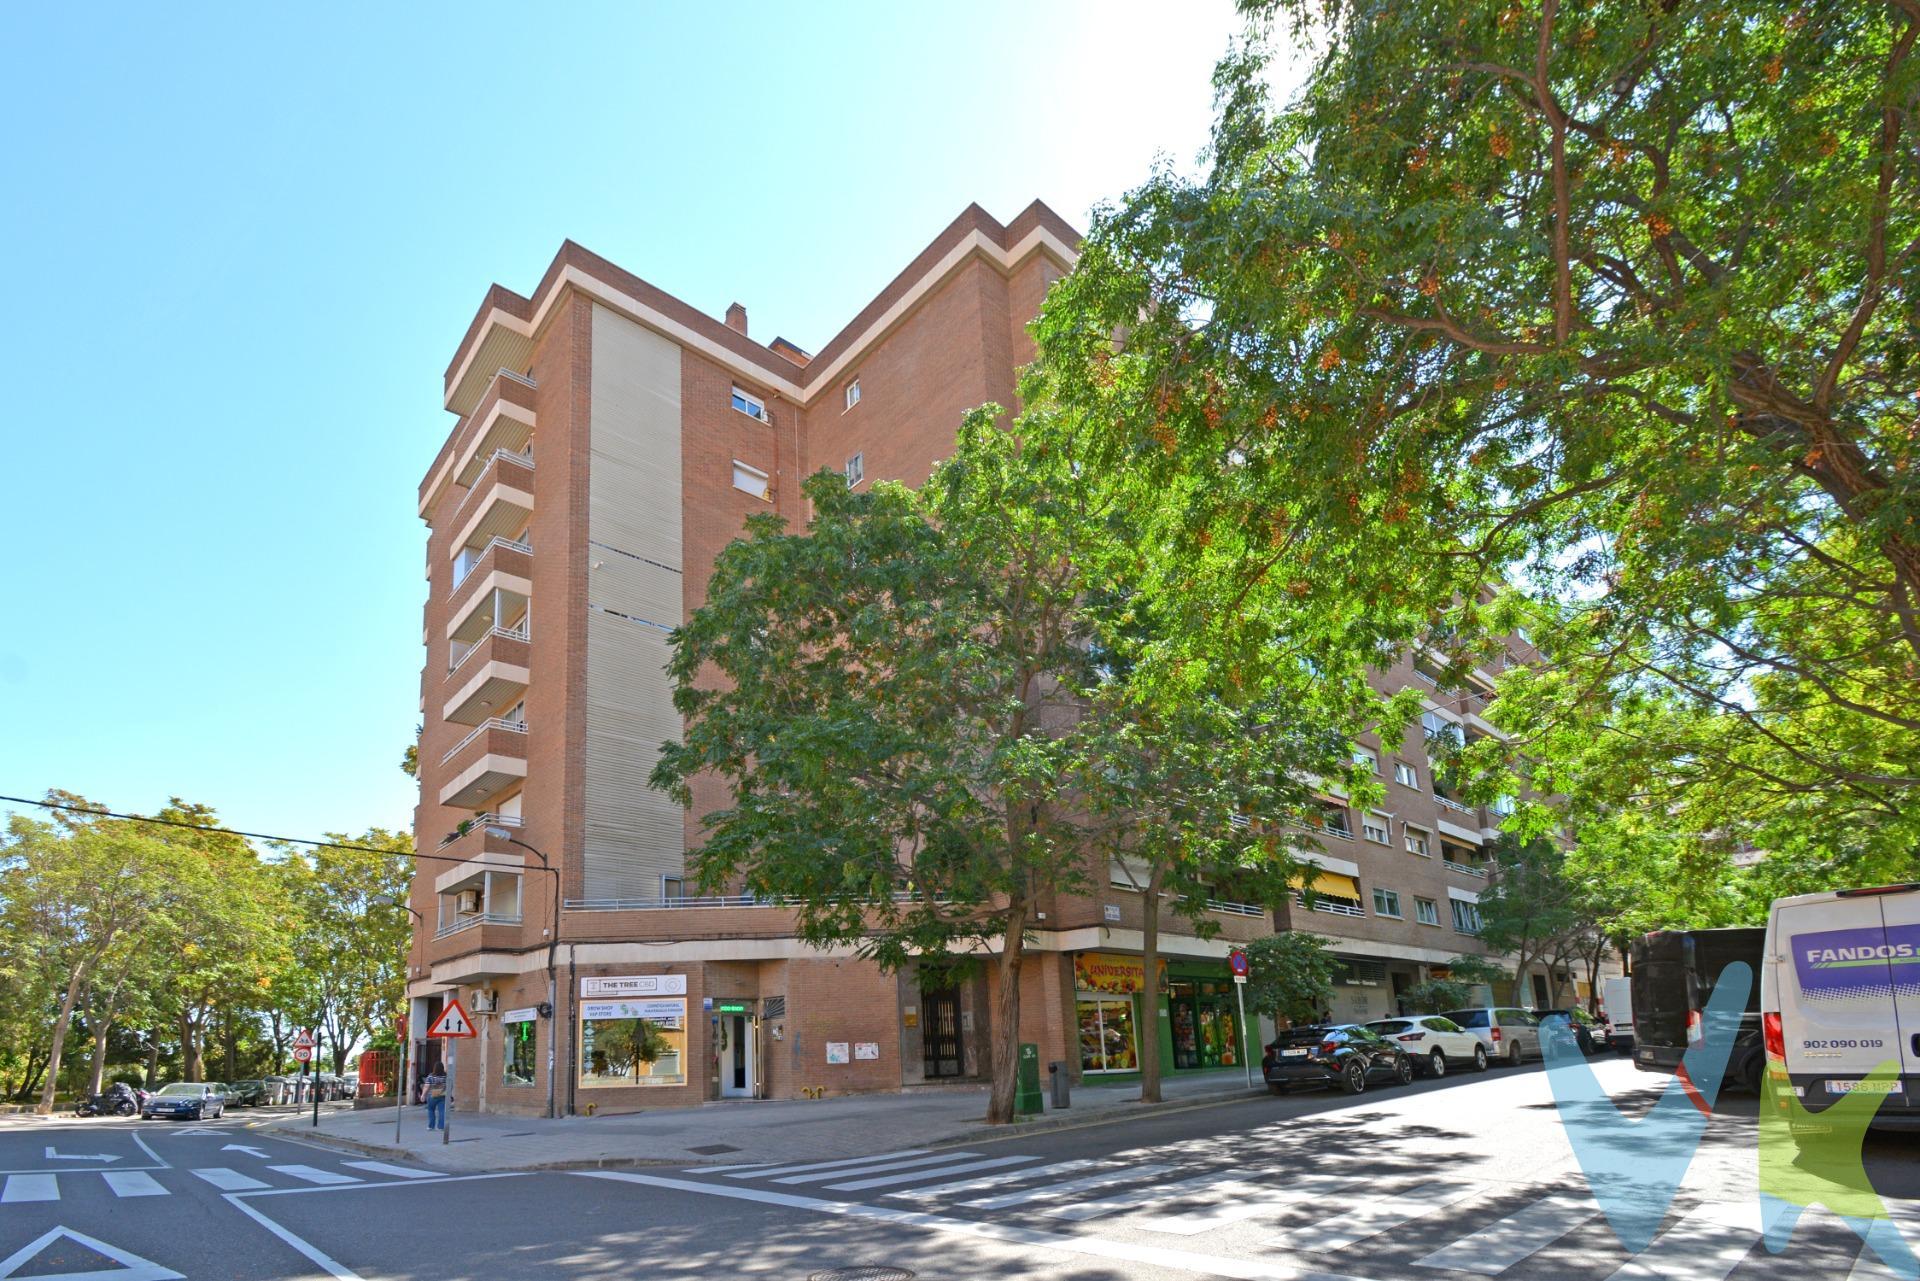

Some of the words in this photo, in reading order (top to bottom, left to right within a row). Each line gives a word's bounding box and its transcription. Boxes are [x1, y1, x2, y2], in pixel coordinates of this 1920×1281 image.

[1807, 944, 1913, 962] FANDOS
[1090, 964, 1145, 977] UNIVERSITA
[639, 980, 655, 988] CBD
[1803, 1039, 1828, 1049] 902
[1830, 1039, 1857, 1048] 090
[1860, 1039, 1883, 1048] 019
